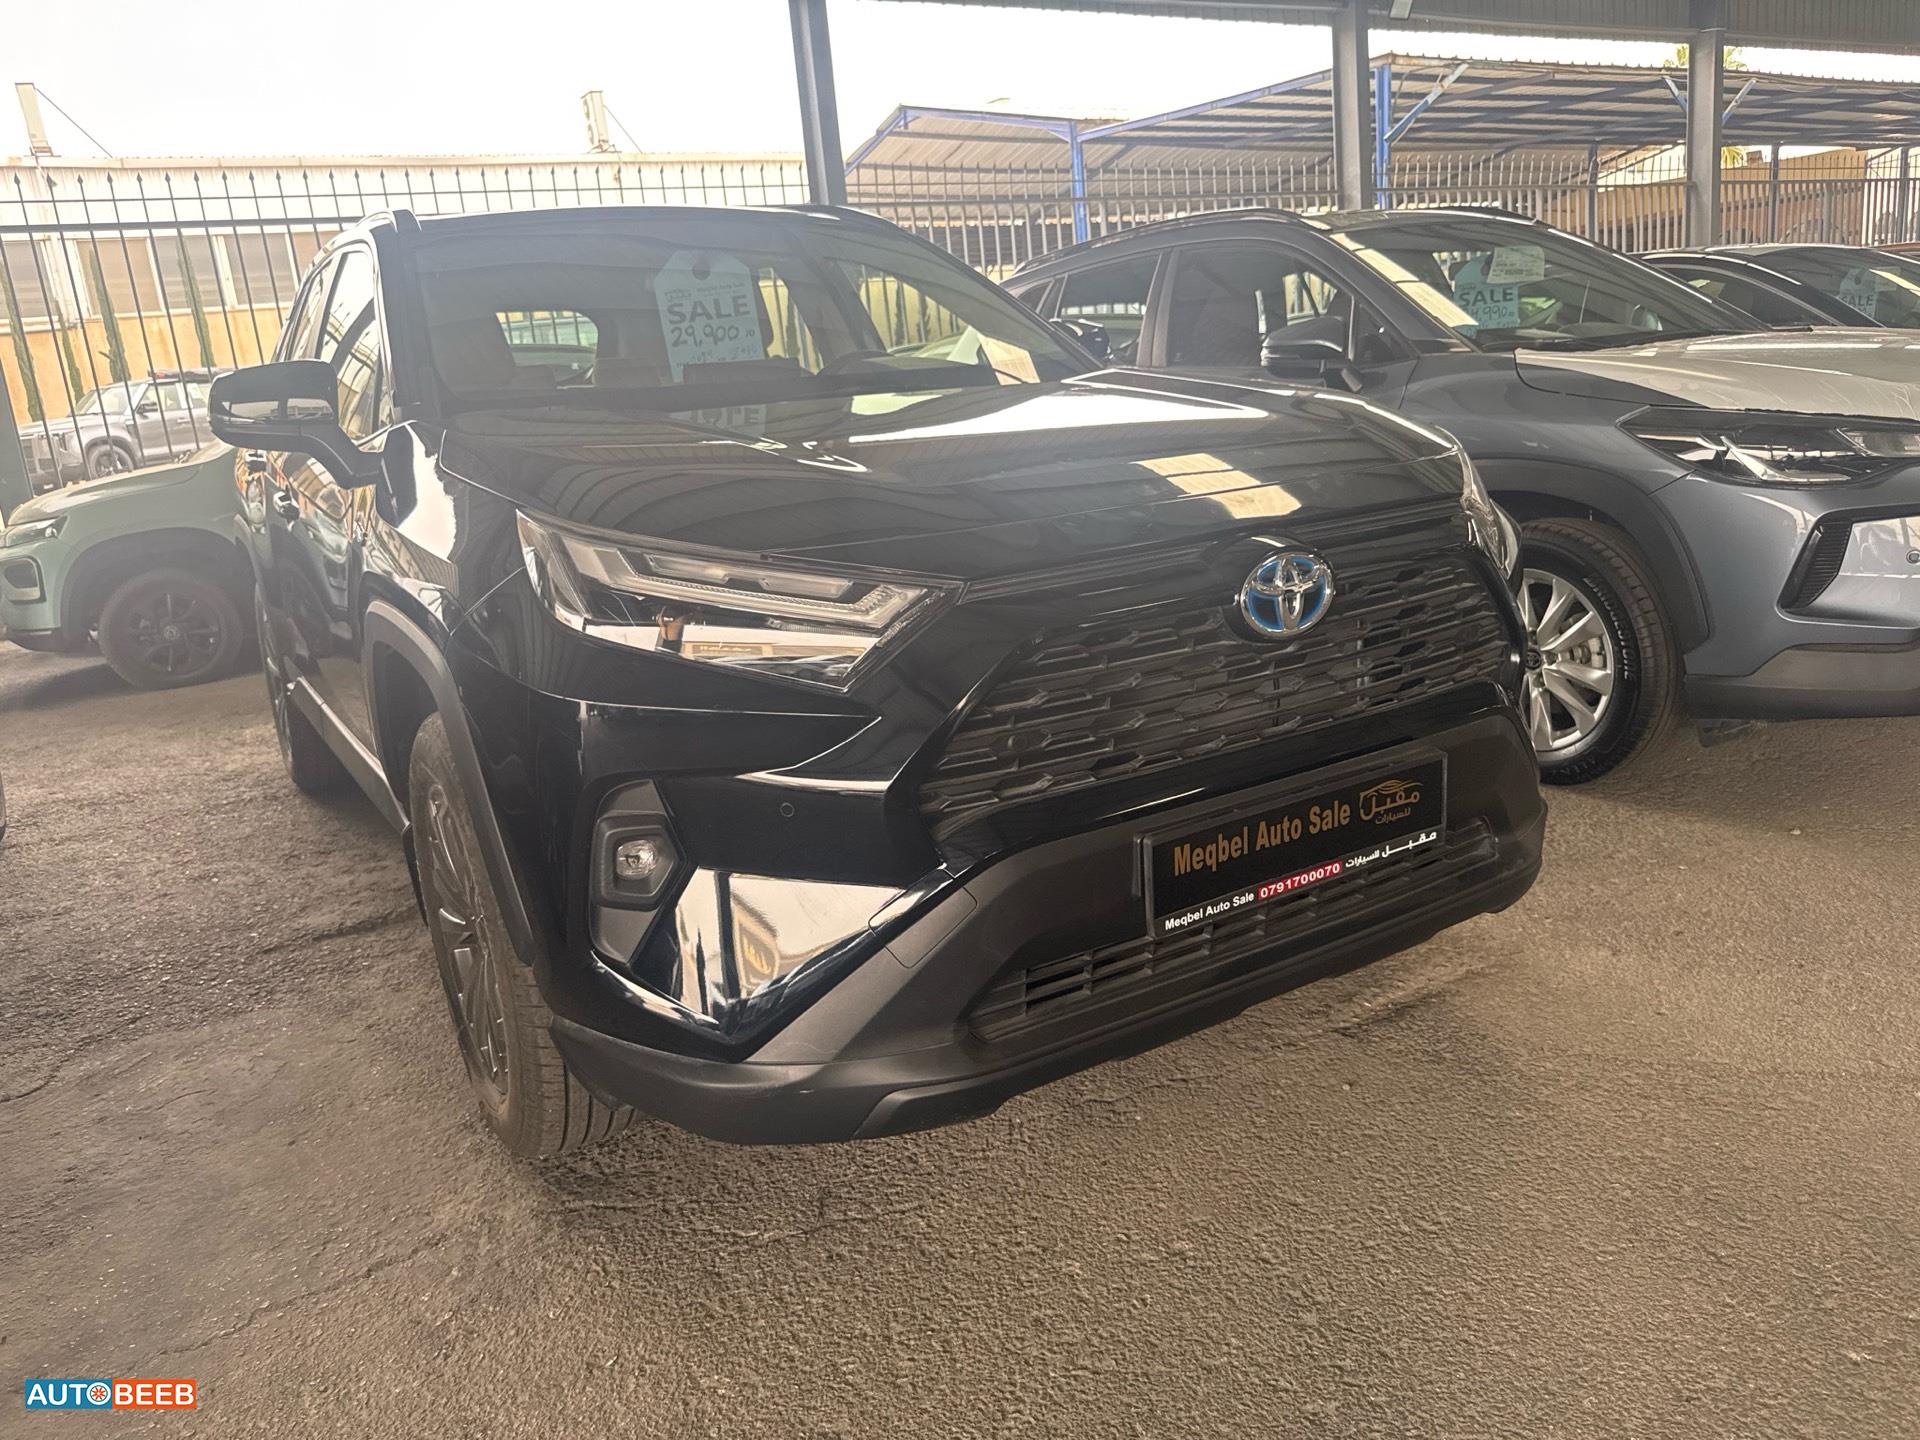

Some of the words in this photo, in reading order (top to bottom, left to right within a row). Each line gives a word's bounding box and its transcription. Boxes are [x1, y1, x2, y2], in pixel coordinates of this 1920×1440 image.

[667, 294, 750, 325] SALE
[1458, 287, 1514, 308] SALE
[1173, 826, 1249, 876] Meqbel
[1255, 815, 1302, 850] Auto
[1308, 800, 1351, 835] Sale
[1345, 849, 1380, 868] للسيارات
[1164, 908, 1204, 931] Meqbel
[1205, 901, 1231, 917] Auto
[1232, 890, 1255, 908] Sale
[1260, 862, 1340, 898] 0791700070
